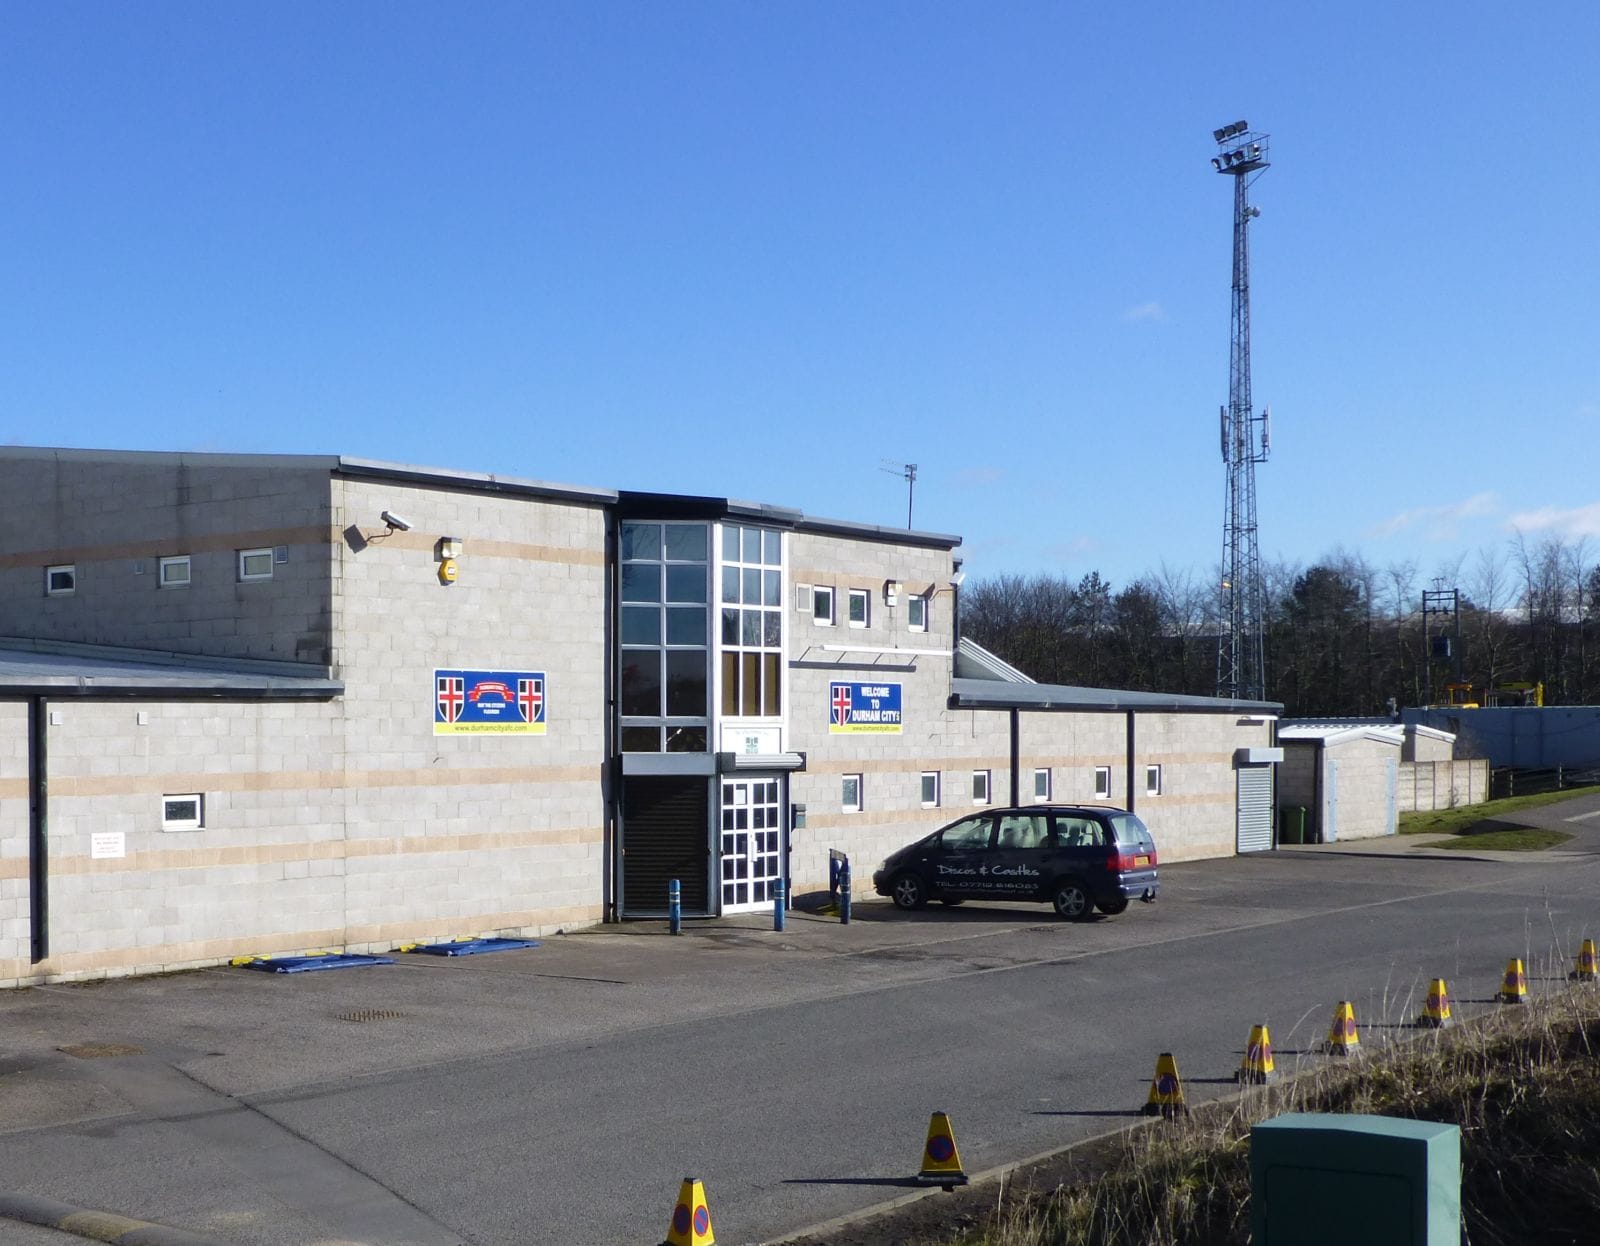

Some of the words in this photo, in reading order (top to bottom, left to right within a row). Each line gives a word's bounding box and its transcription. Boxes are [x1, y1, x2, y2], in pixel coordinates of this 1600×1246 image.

[861, 687, 890, 697] WELCOME
[871, 699, 880, 709] TO
[852, 710, 880, 722] DURHAM
[881, 710, 896, 722] CITY
[936, 864, 977, 875] Discos
[979, 864, 989, 876] &
[991, 864, 1040, 876] Castles
